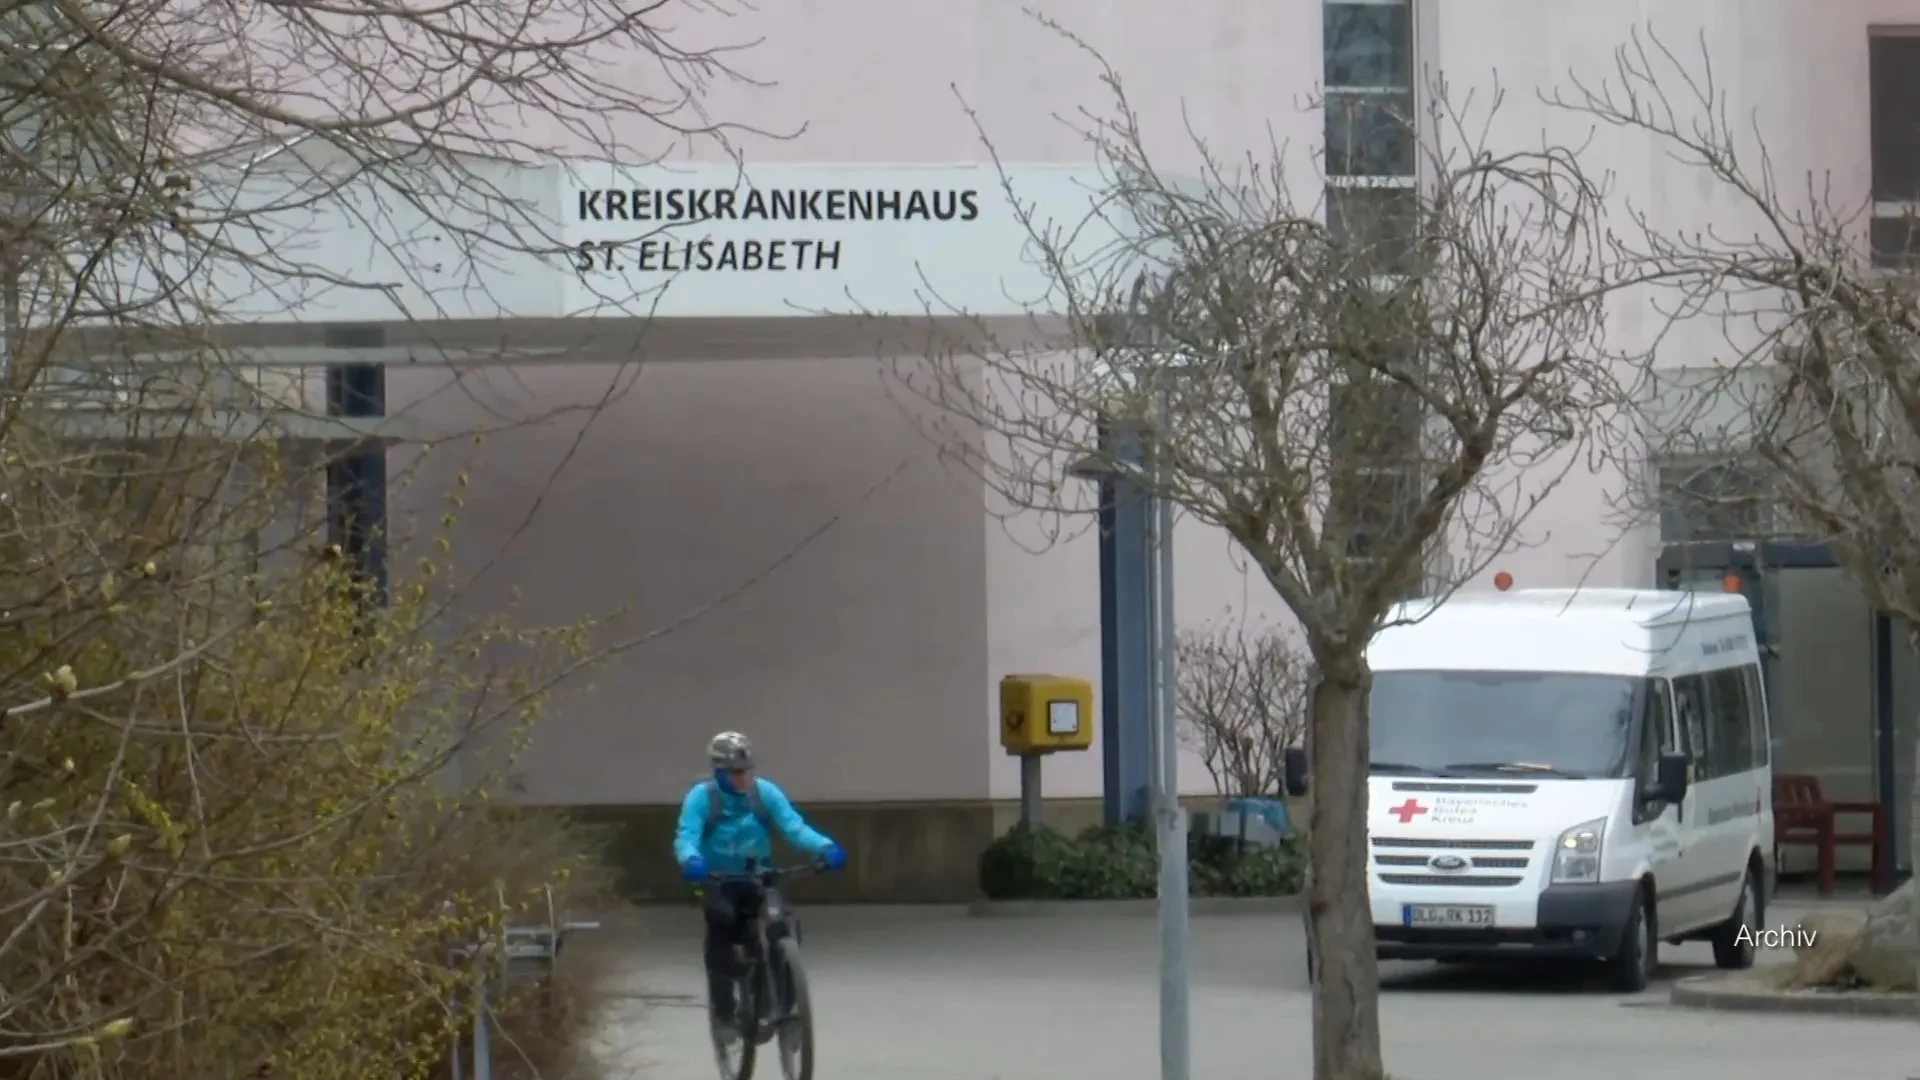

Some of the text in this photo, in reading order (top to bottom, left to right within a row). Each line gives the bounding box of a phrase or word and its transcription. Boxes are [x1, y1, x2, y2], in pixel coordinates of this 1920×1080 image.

[579, 189, 979, 221] KREISKRANKENHAUS
[577, 240, 841, 271] ST. ELISABETH
